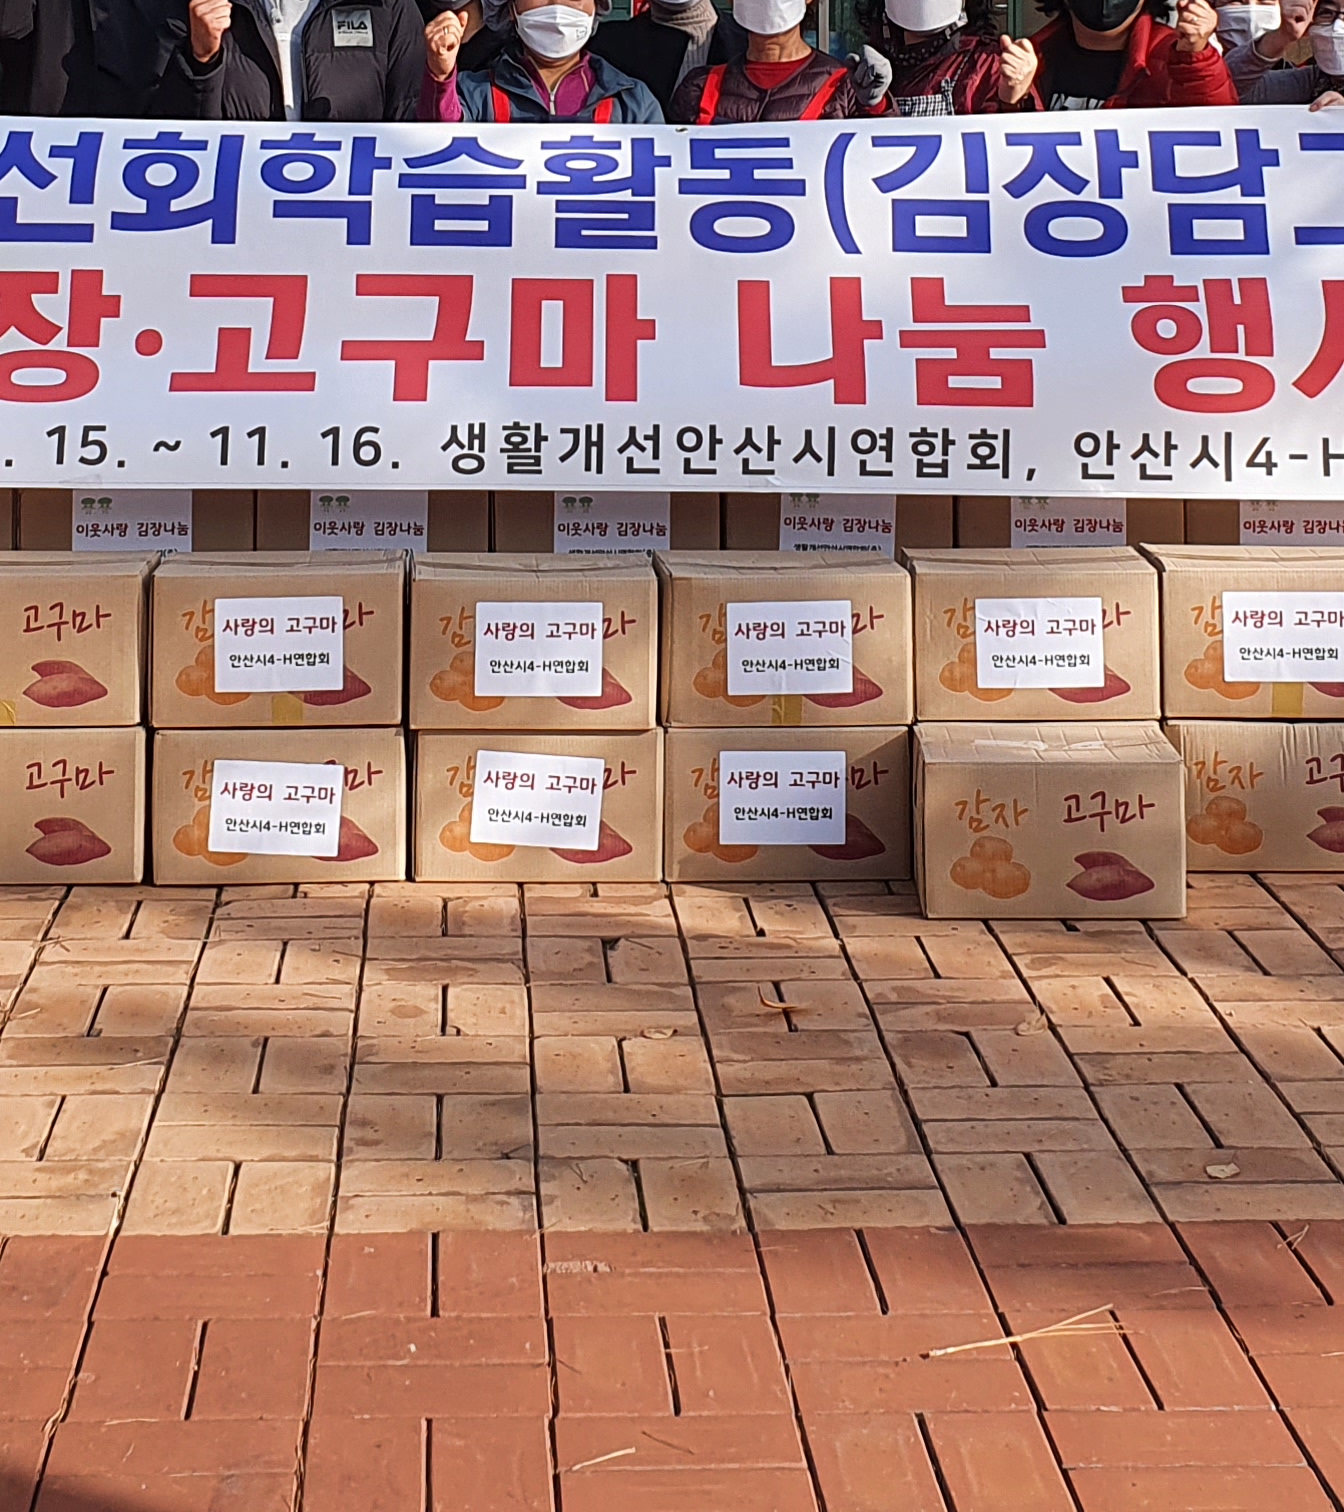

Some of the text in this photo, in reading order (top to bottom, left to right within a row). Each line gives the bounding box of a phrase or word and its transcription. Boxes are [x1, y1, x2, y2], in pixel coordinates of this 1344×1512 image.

[337, 20, 368, 30] FILA
[737, 275, 1046, 409] 나눔
[45, 424, 126, 469] 15.
[208, 425, 289, 470] 11.
[318, 425, 399, 471] 16.
[439, 420, 1037, 483] 생활개선안산시연합회,
[76, 521, 189, 538] 이웃사랑 김장나눔
[314, 521, 425, 536] 이웃사랑 김장나눔
[557, 522, 667, 537] 이웃사랑 김장나눔
[784, 516, 893, 533] 이웃사랑 김장나눔
[1015, 518, 1124, 533] 이웃사랑 김장나눔
[1243, 519, 1295, 534] 이웃사랑
[23, 601, 112, 642] 고구마
[222, 616, 338, 637] 사랑의 고구마
[984, 618, 1096, 637] 사랑의 고구마
[1231, 610, 1283, 628] 사랑의
[1293, 610, 1344, 628] 고구마
[483, 622, 535, 641] 사랑의
[545, 622, 597, 640] 고구마
[734, 621, 786, 641] 사랑의
[796, 620, 846, 638] 고구마
[229, 652, 330, 668] 안산시4-H연합회
[991, 654, 1090, 668] 안산시4-H연합회
[1239, 647, 1338, 661] 안산시4-H연합회
[489, 659, 589, 674] 안산시4-H연합회
[741, 658, 840, 673] 안산시4-H연합회
[26, 758, 115, 799] 고구마
[727, 771, 779, 789] 사랑의
[788, 771, 840, 789] 고구마
[1193, 751, 1265, 793] 감자
[483, 770, 535, 791] 사랑의
[545, 775, 597, 795] 고구마
[220, 782, 336, 804] 사랑의 고구마
[487, 807, 587, 828] 안산시4-H연합회
[733, 807, 833, 821] 안산시4-H연합회
[955, 789, 1156, 833] 감자 고구마
[225, 817, 326, 835] 안산시4-H연합회
